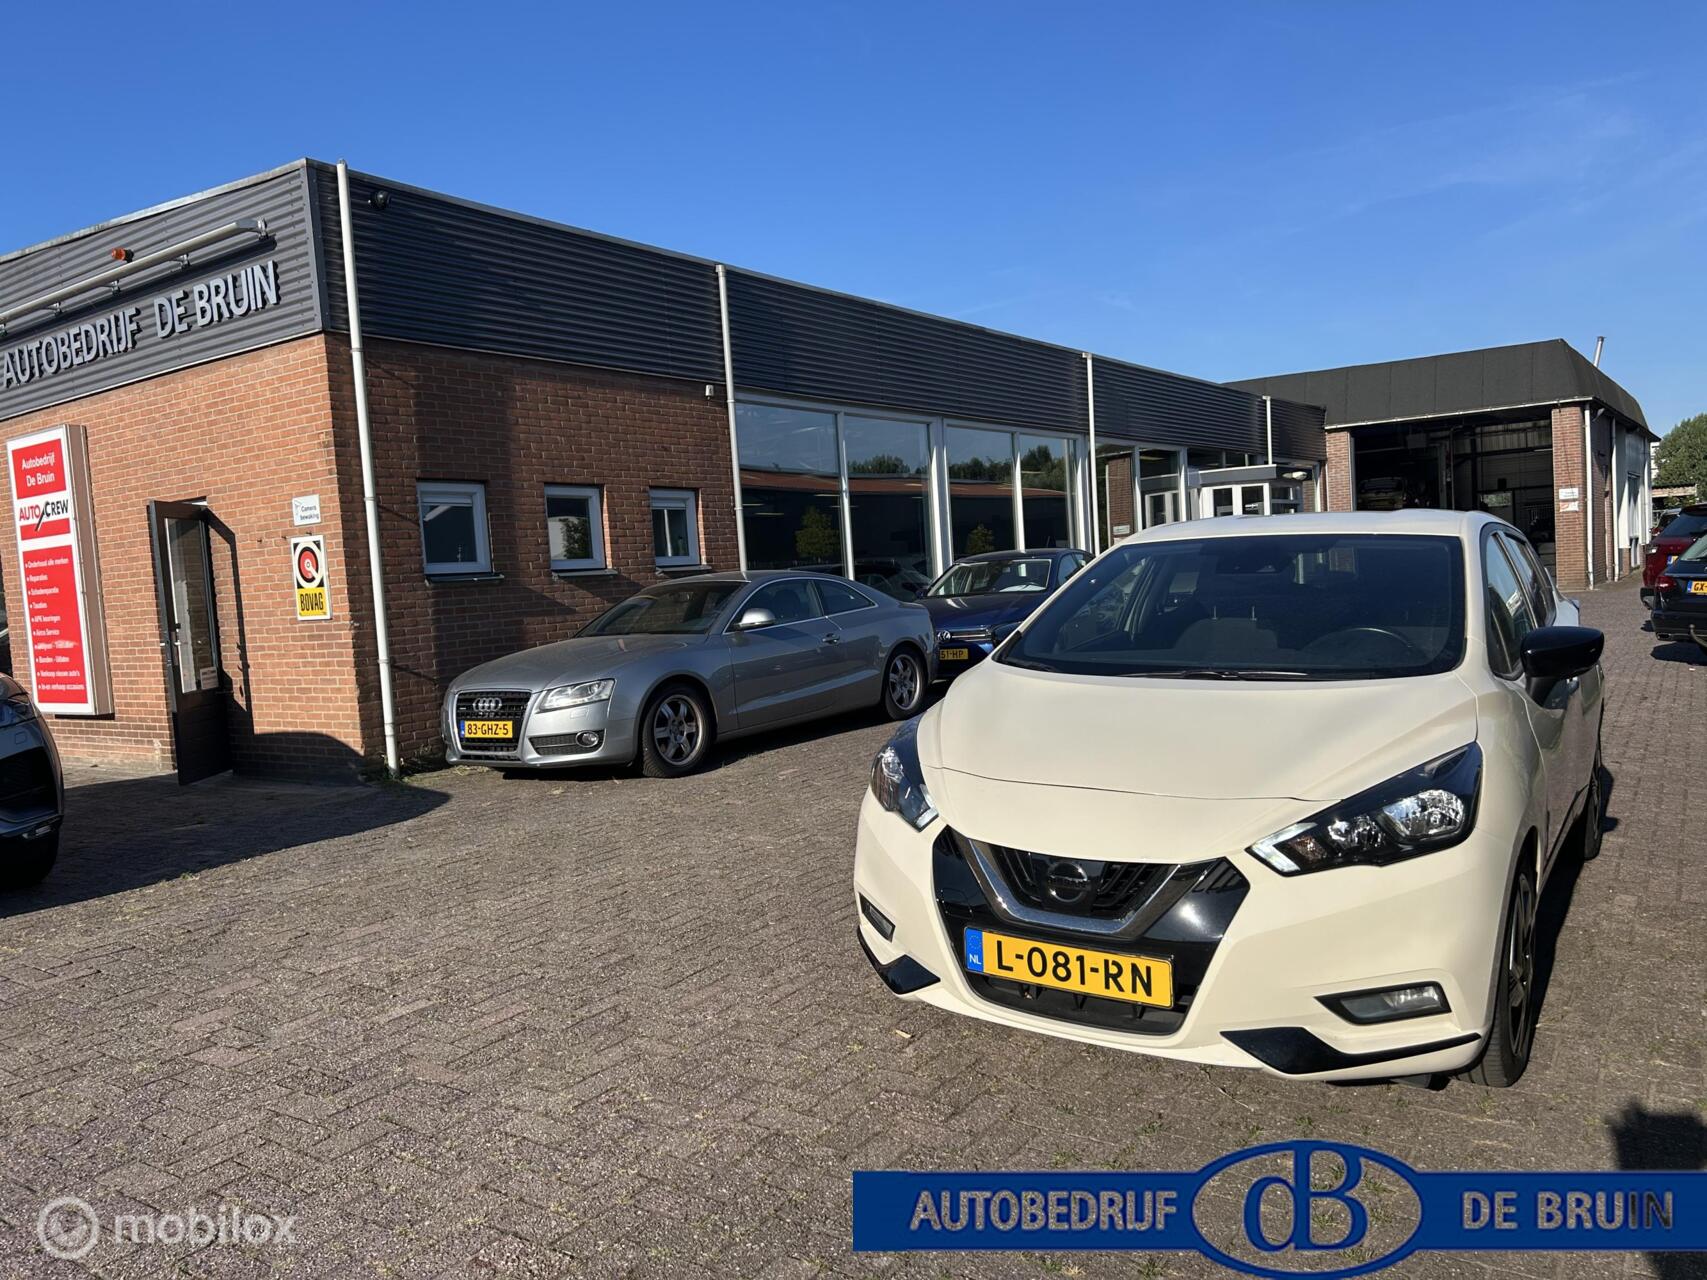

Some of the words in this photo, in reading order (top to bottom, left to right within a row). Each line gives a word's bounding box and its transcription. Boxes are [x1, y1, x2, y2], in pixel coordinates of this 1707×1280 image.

[2, 307, 139, 387] AUTOBEDRIJF
[154, 292, 189, 338] DE
[193, 260, 278, 327] BRUIN
[26, 475, 36, 487] De
[36, 471, 55, 485] Bruin
[300, 592, 324, 611] BOVAG
[467, 723, 509, 736] 83-GHZ-5
[969, 954, 982, 966] NL
[996, 940, 1152, 997] L-081-RN
